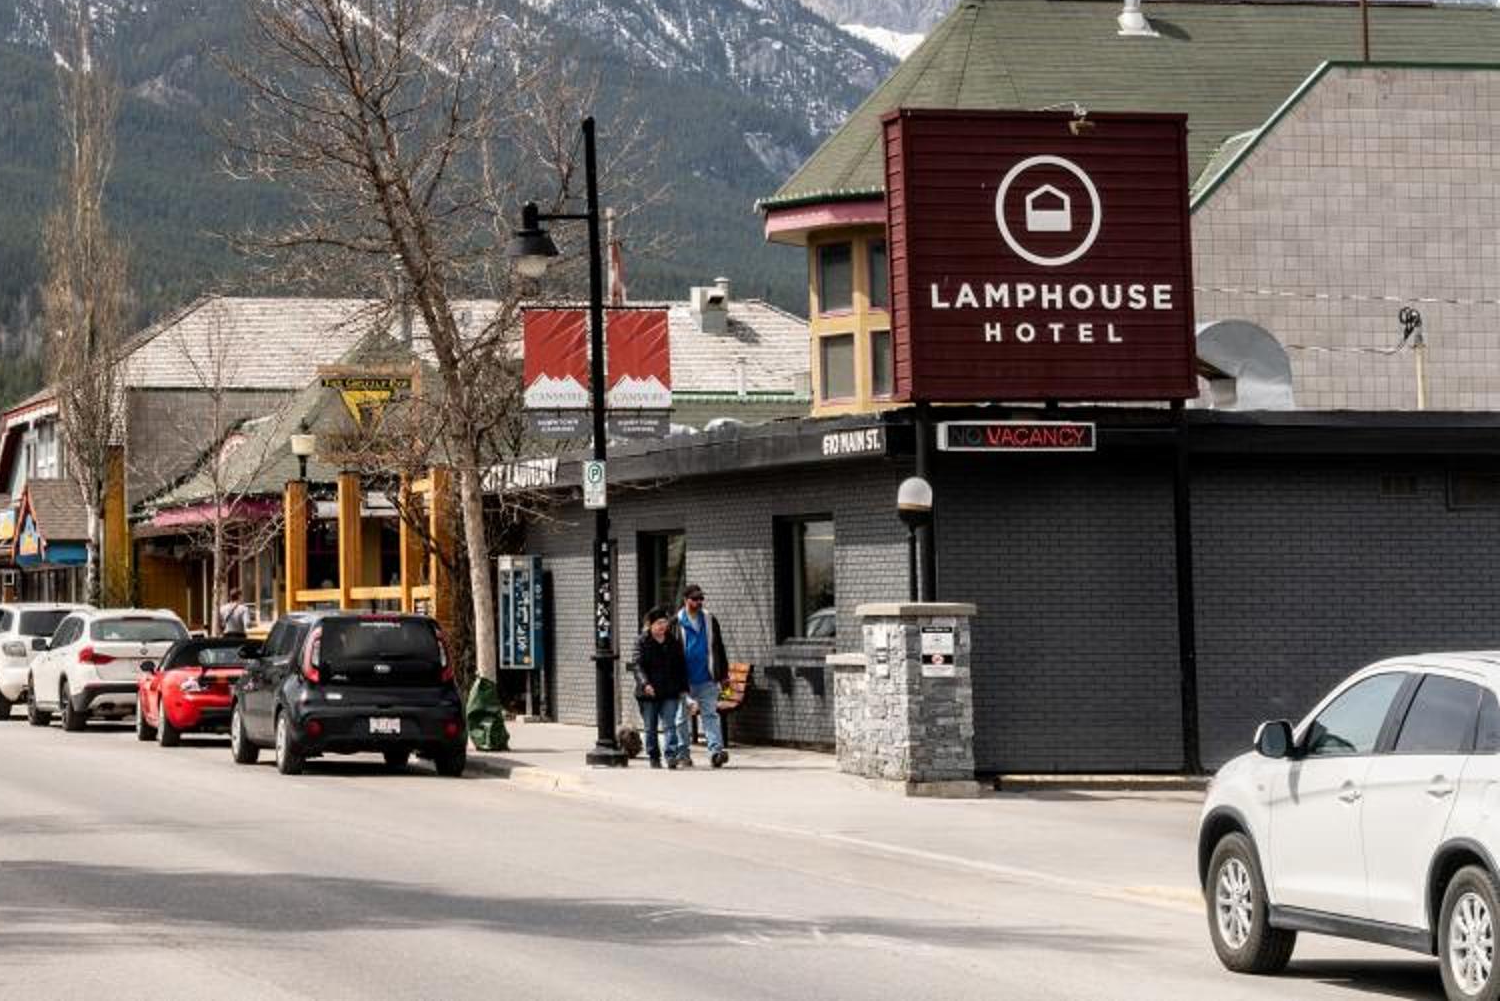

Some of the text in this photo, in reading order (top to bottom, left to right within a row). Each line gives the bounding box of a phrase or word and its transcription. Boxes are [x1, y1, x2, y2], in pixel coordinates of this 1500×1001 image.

[930, 283, 1173, 310] LAMPHOUSE
[984, 322, 1123, 343] HOTEL
[840, 430, 865, 453] MAIN
[866, 428, 881, 450] ST.
[951, 425, 1085, 445] NO VACANCY
